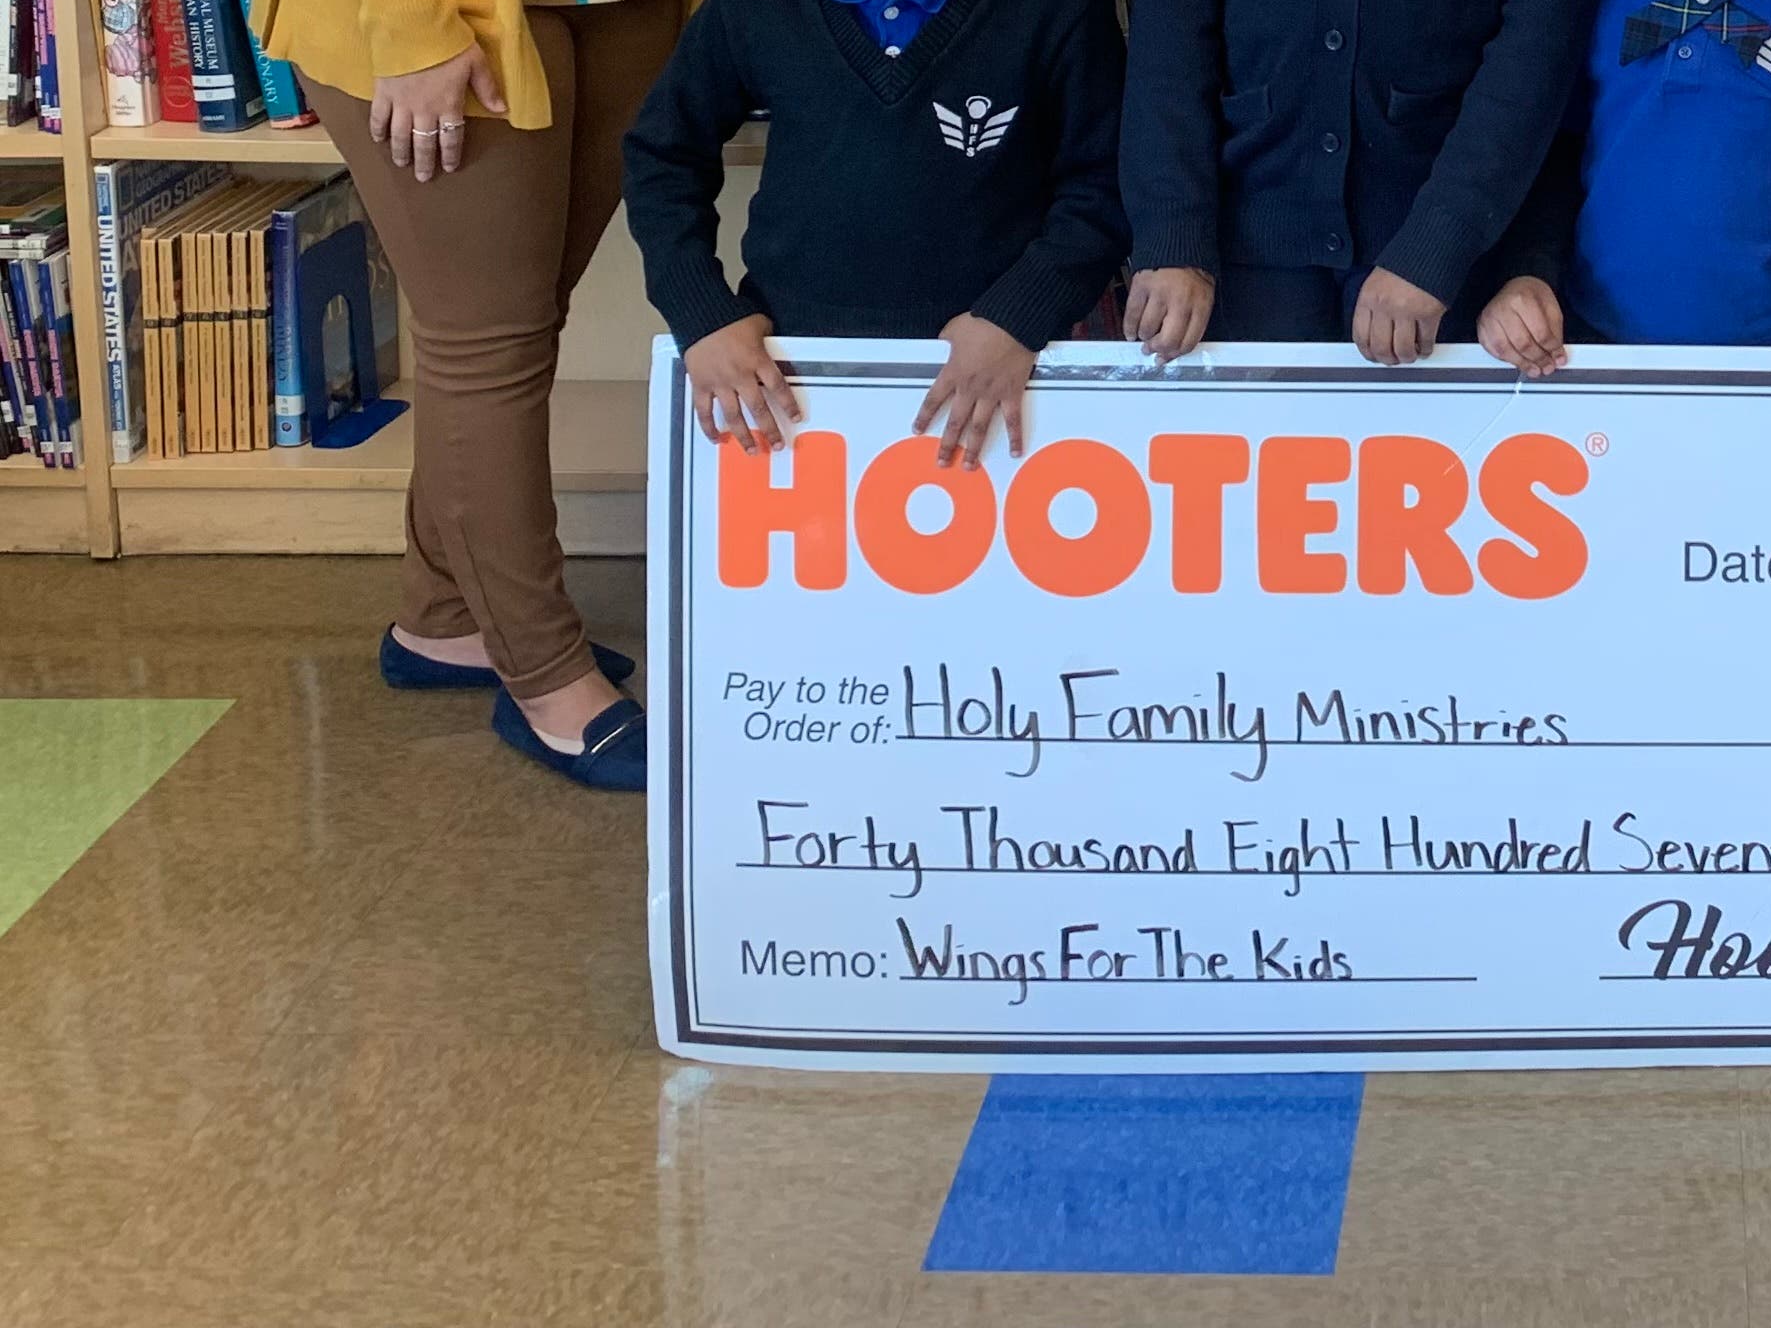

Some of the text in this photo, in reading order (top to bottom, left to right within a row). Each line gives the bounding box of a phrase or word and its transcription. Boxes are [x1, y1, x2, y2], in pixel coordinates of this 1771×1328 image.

[189, 21, 205, 71] HISTORY
[204, 17, 220, 71] MUSEUM
[98, 214, 117, 289] UNITED
[103, 289, 122, 364] STATES
[723, 677, 889, 708] Pay to the
[744, 663, 1569, 782] Order of: Holy Family Ministries
[755, 798, 925, 899] Forty
[940, 804, 1196, 873] Thousand
[1223, 818, 1360, 896] Eight
[1381, 812, 1593, 874] Hundred
[741, 916, 1353, 1006] Memo: Wings For The Kids
